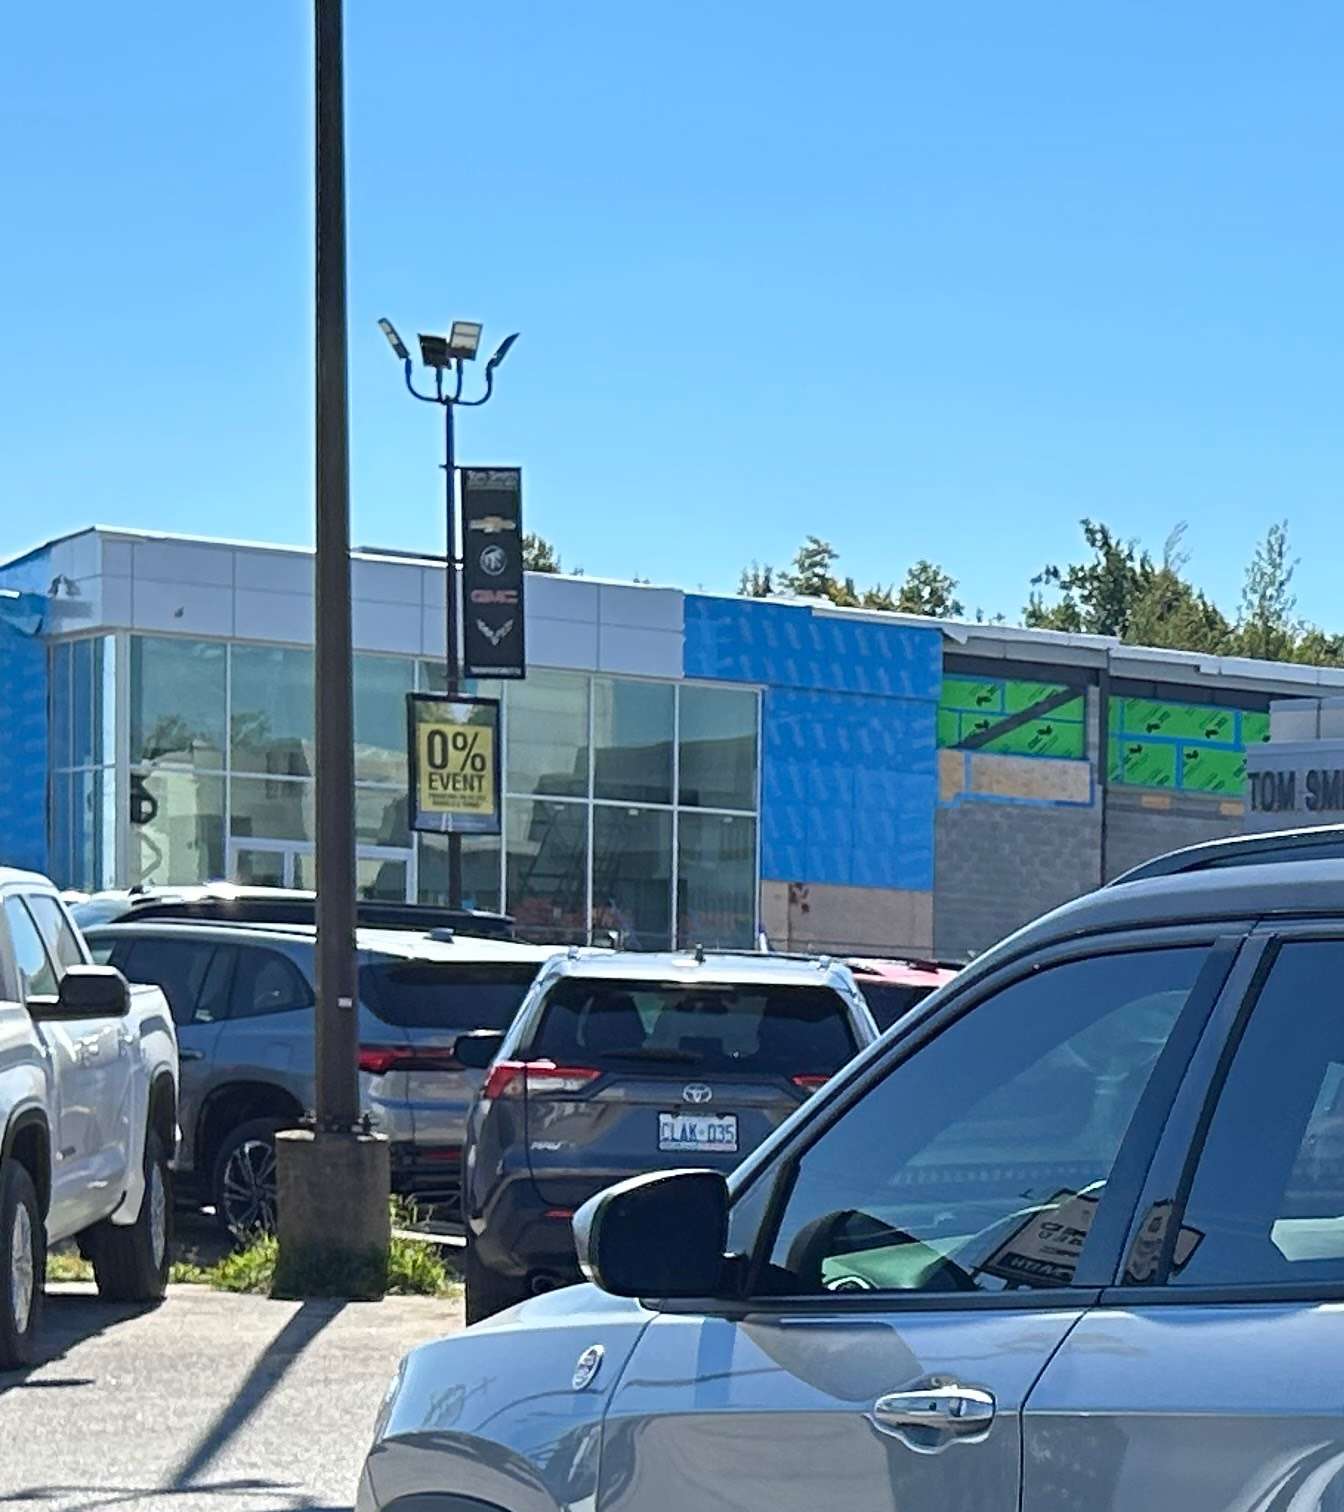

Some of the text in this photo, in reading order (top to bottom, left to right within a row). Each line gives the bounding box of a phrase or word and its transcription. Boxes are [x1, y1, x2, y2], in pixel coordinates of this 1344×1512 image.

[427, 729, 487, 773] 0%
[428, 771, 485, 793] EVENT
[1247, 770, 1296, 812] TOM
